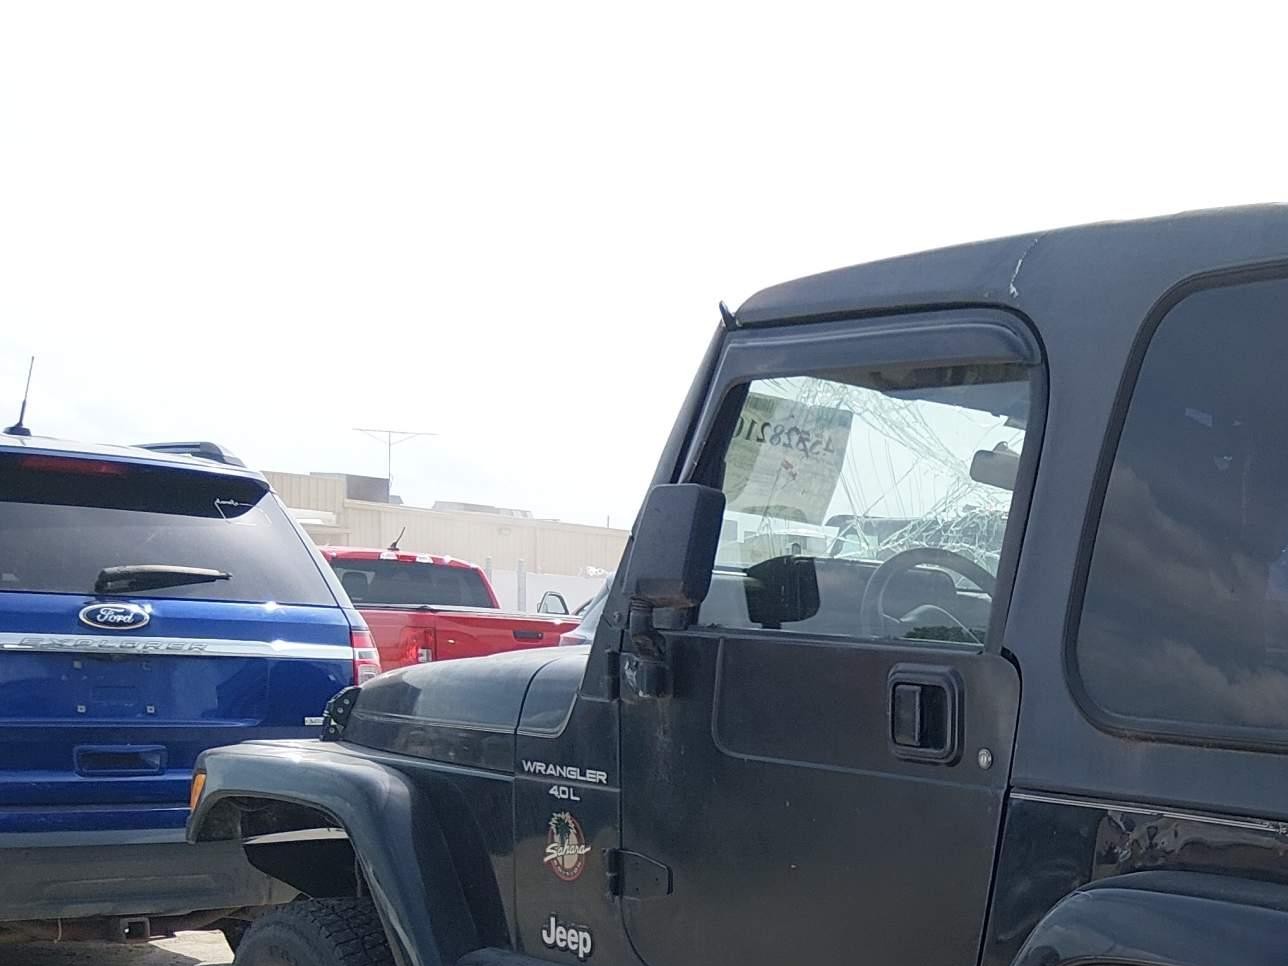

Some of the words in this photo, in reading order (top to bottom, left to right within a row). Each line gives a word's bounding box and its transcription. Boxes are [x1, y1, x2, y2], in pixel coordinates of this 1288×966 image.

[96, 607, 135, 625] Ford
[19, 636, 210, 653] EXPLORER
[521, 759, 608, 785] WRANGLER
[544, 838, 591, 863] Sahara
[541, 916, 592, 958] Jeep
